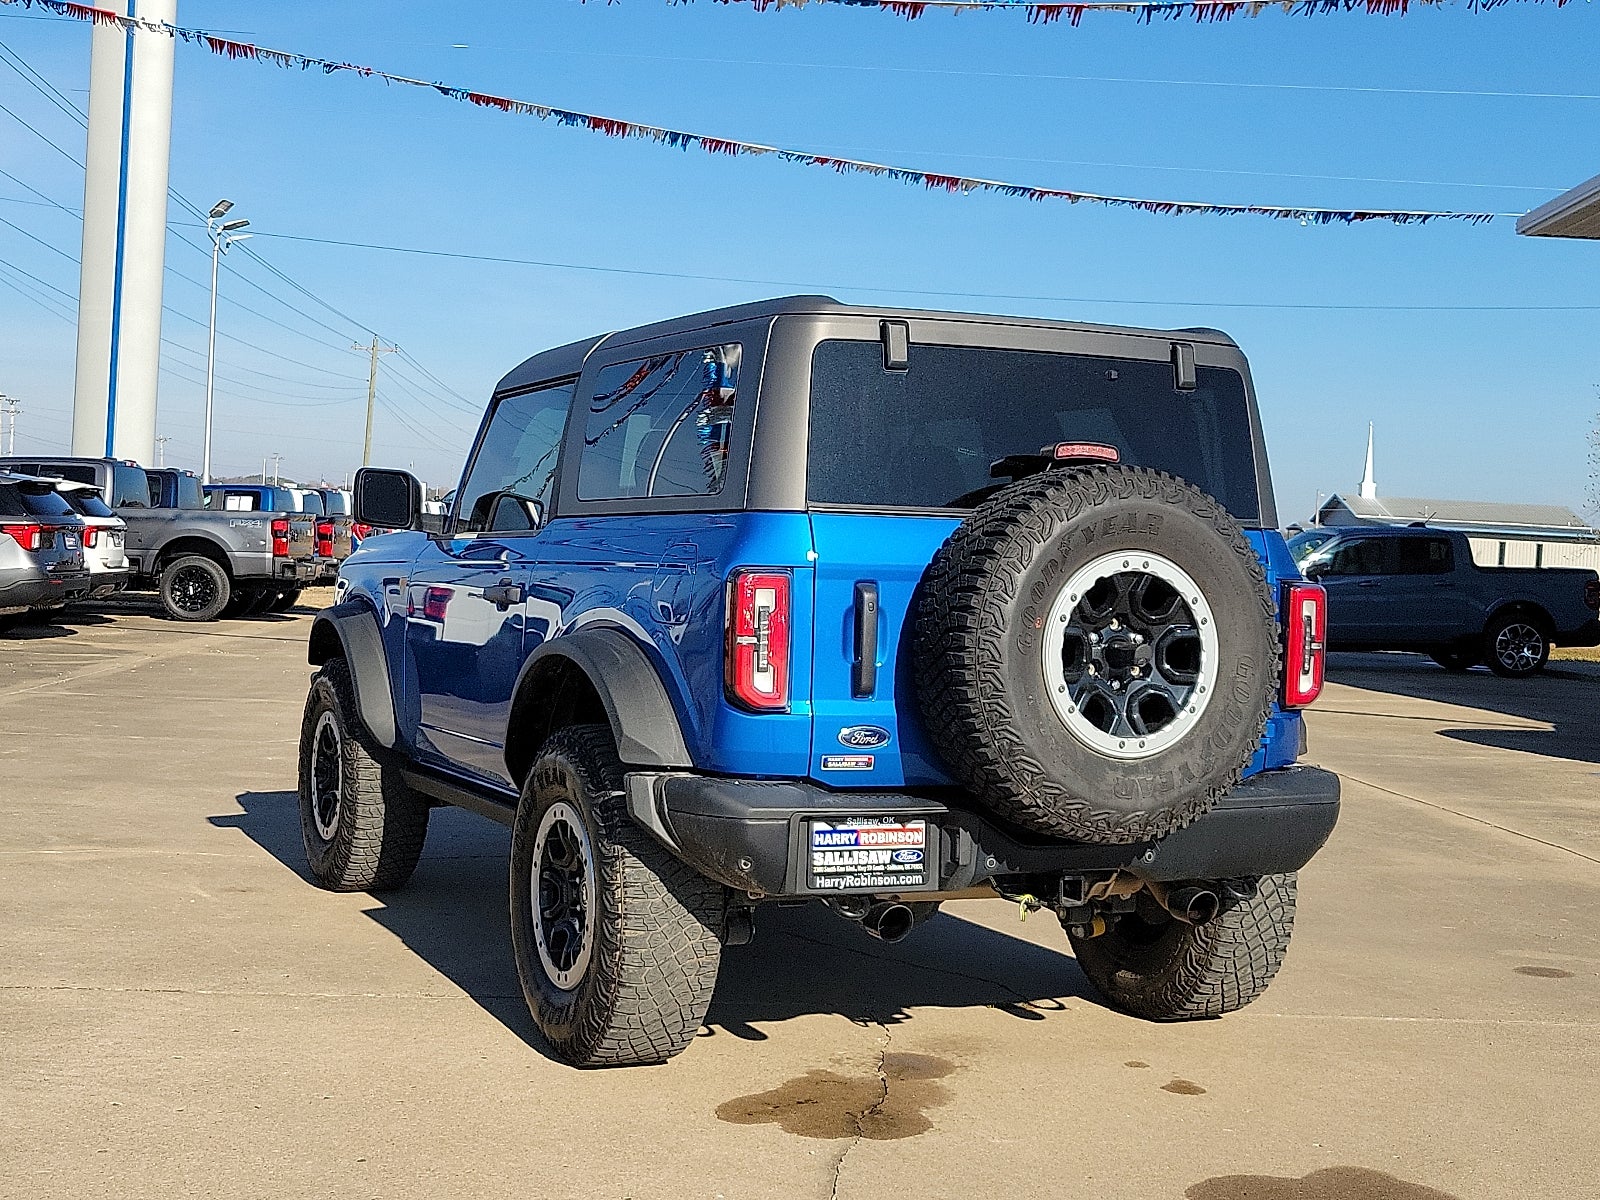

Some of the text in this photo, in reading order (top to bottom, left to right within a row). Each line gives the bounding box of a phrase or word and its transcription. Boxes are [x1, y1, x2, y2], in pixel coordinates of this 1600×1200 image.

[850, 730, 880, 745] Ford
[846, 816, 895, 826] Sallisaw, OK
[814, 831, 922, 846] HARRY ROBINSON
[813, 849, 892, 865] SALLISAW
[897, 850, 919, 861] Ford
[816, 874, 923, 890] HarryRobinson.com
